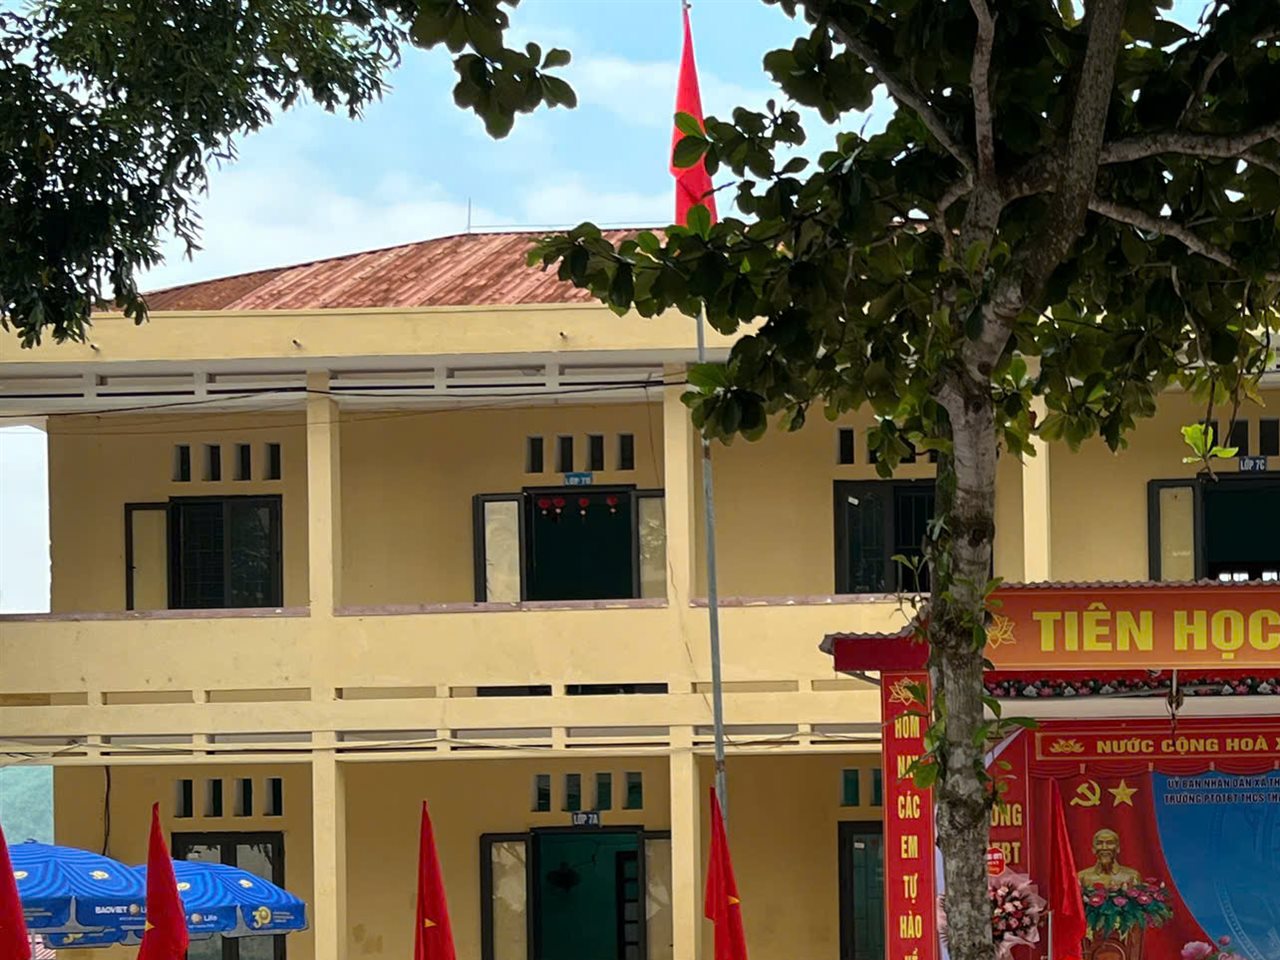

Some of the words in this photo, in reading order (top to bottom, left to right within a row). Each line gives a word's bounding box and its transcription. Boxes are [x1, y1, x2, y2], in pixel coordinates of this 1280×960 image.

[1032, 602, 1153, 652] TIÊN
[1096, 737, 1155, 754] NƯỚC
[1161, 736, 1219, 756] CỘNG
[1225, 734, 1269, 751] HOÀ
[897, 791, 921, 820] CÁC
[901, 835, 918, 859] EM
[903, 873, 918, 904] TỰ
[900, 911, 923, 938] HÀO
